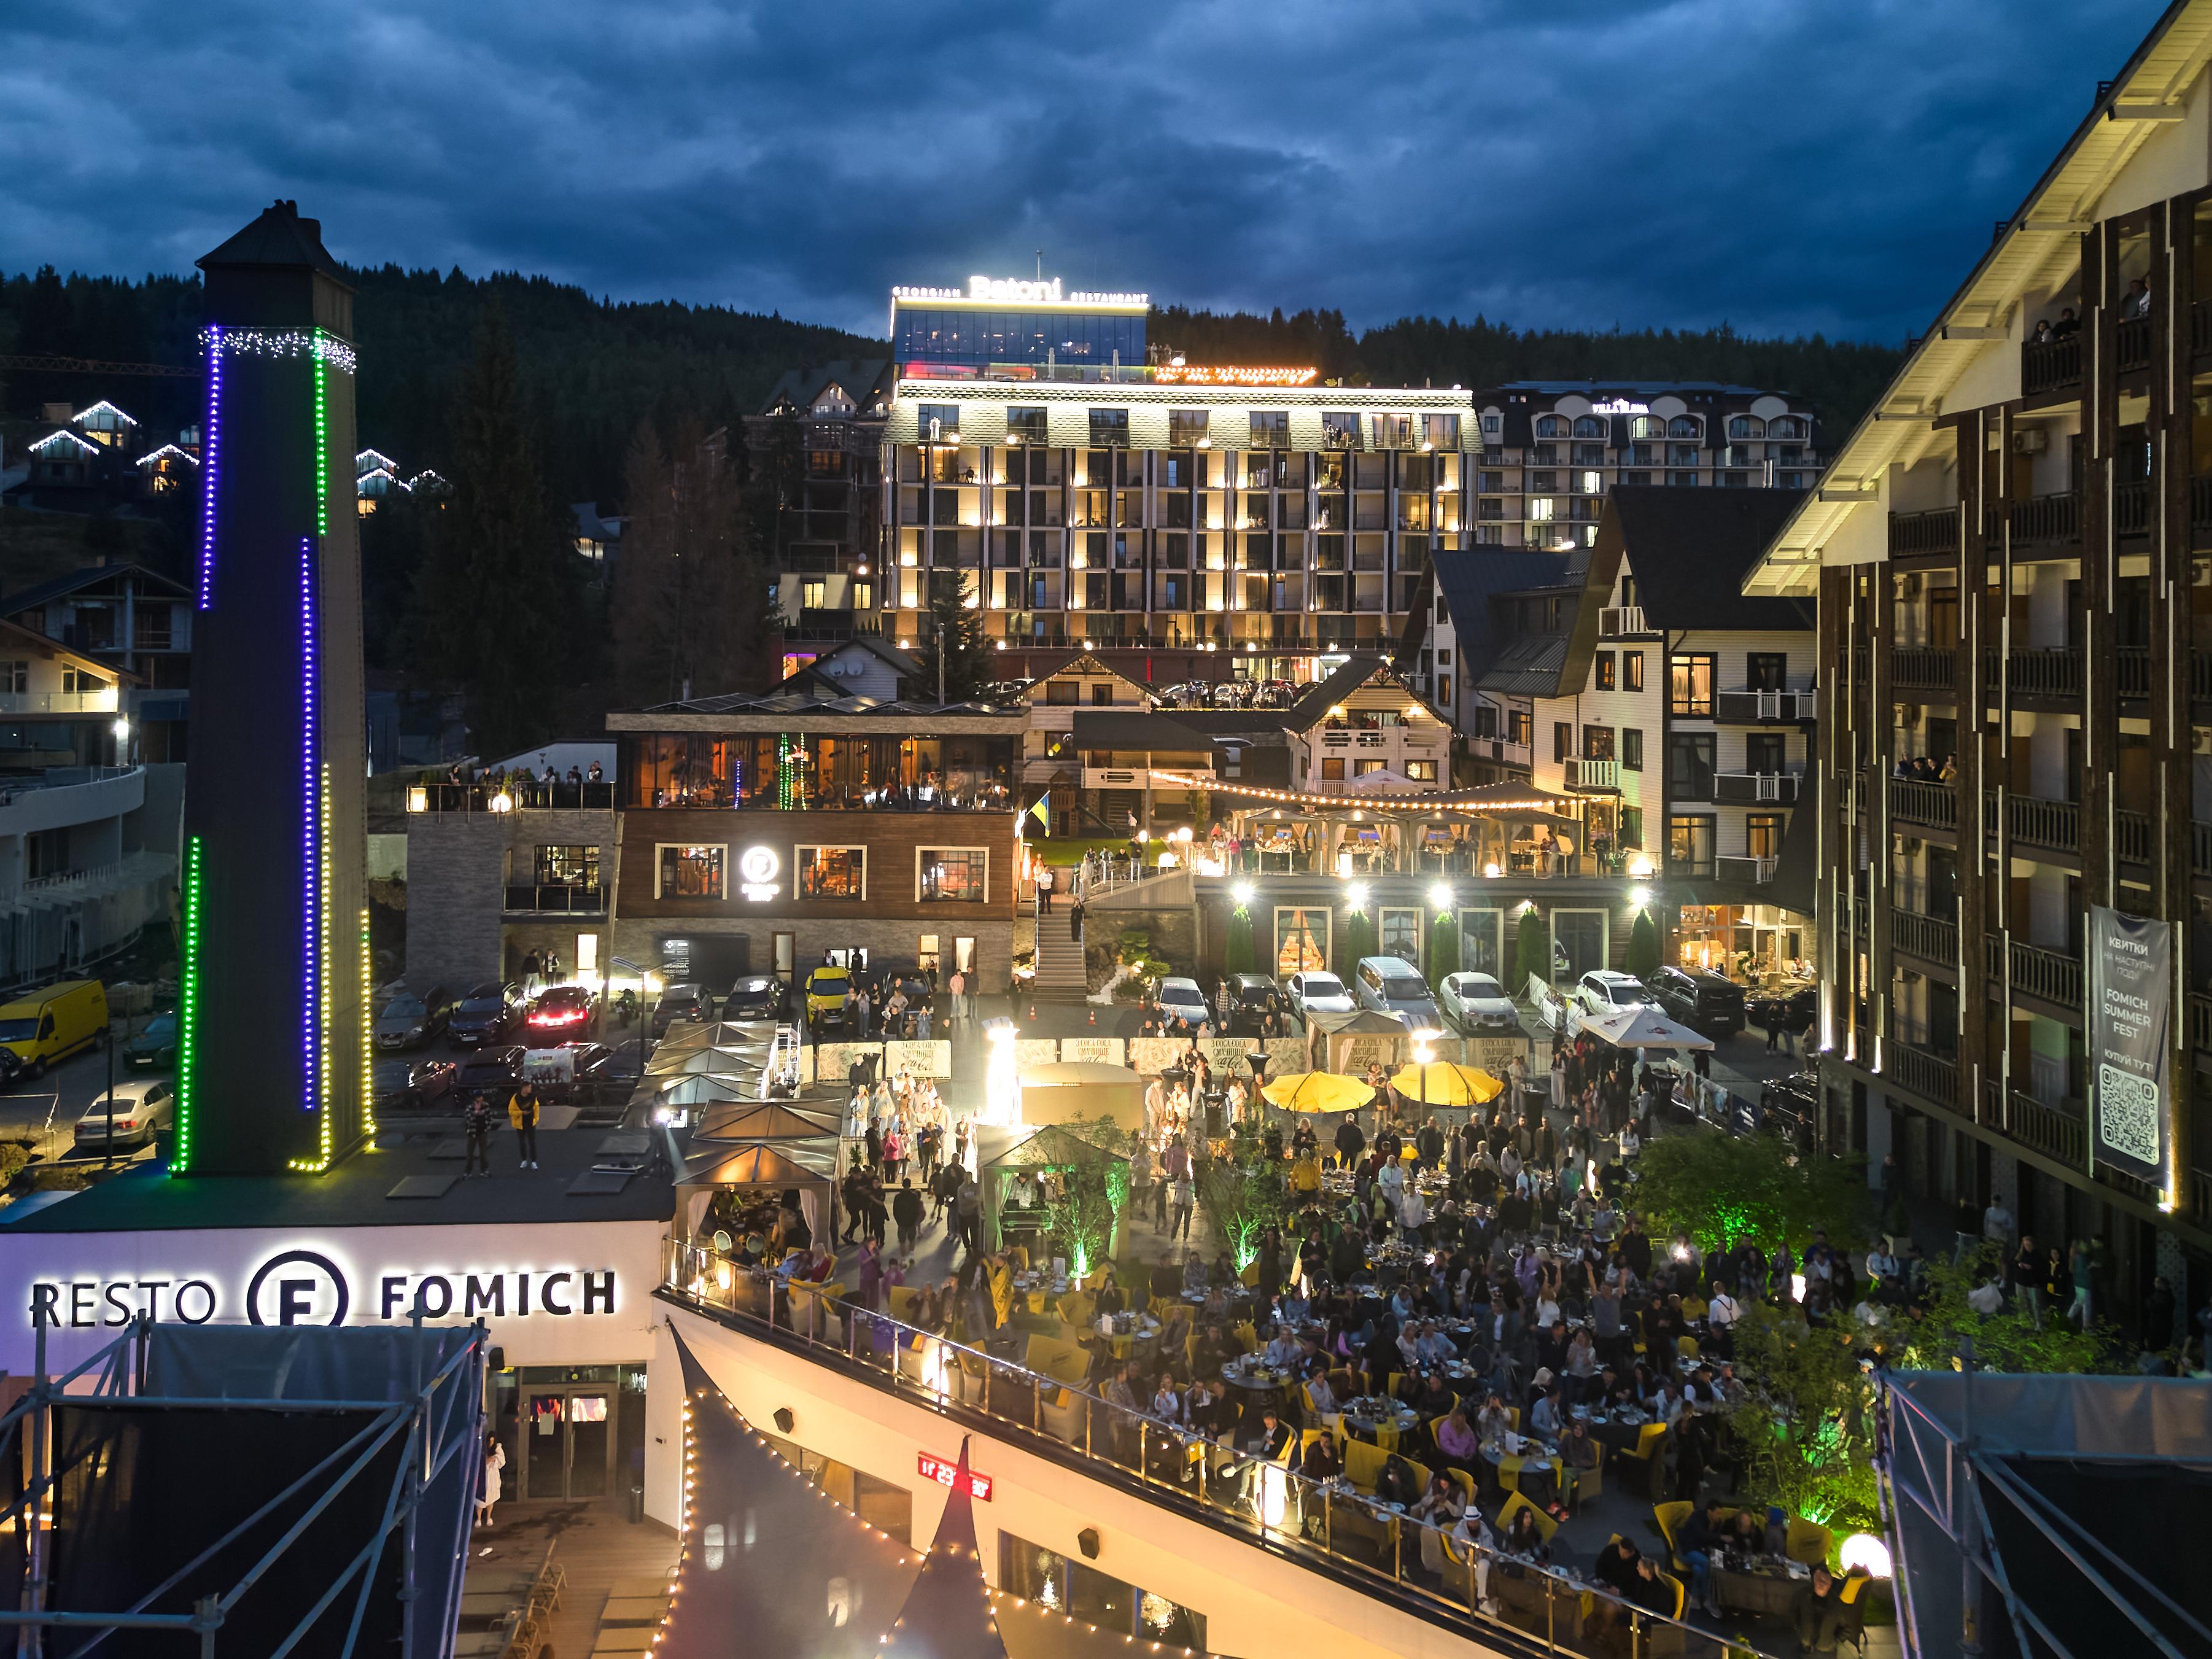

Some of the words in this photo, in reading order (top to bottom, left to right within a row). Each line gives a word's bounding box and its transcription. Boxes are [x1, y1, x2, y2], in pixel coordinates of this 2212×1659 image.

[1071, 292, 1149, 303] RESTAURANT
[2109, 936, 2148, 956] КВИТКИ
[2106, 988, 2148, 1011] FOMICH
[2105, 1003, 2151, 1028] SUMMER
[2114, 1021, 2139, 1038] FEST
[2105, 1048, 2132, 1066] КУПУЙ
[33, 1280, 216, 1327] RESTO
[381, 1272, 615, 1319] FOMICH
